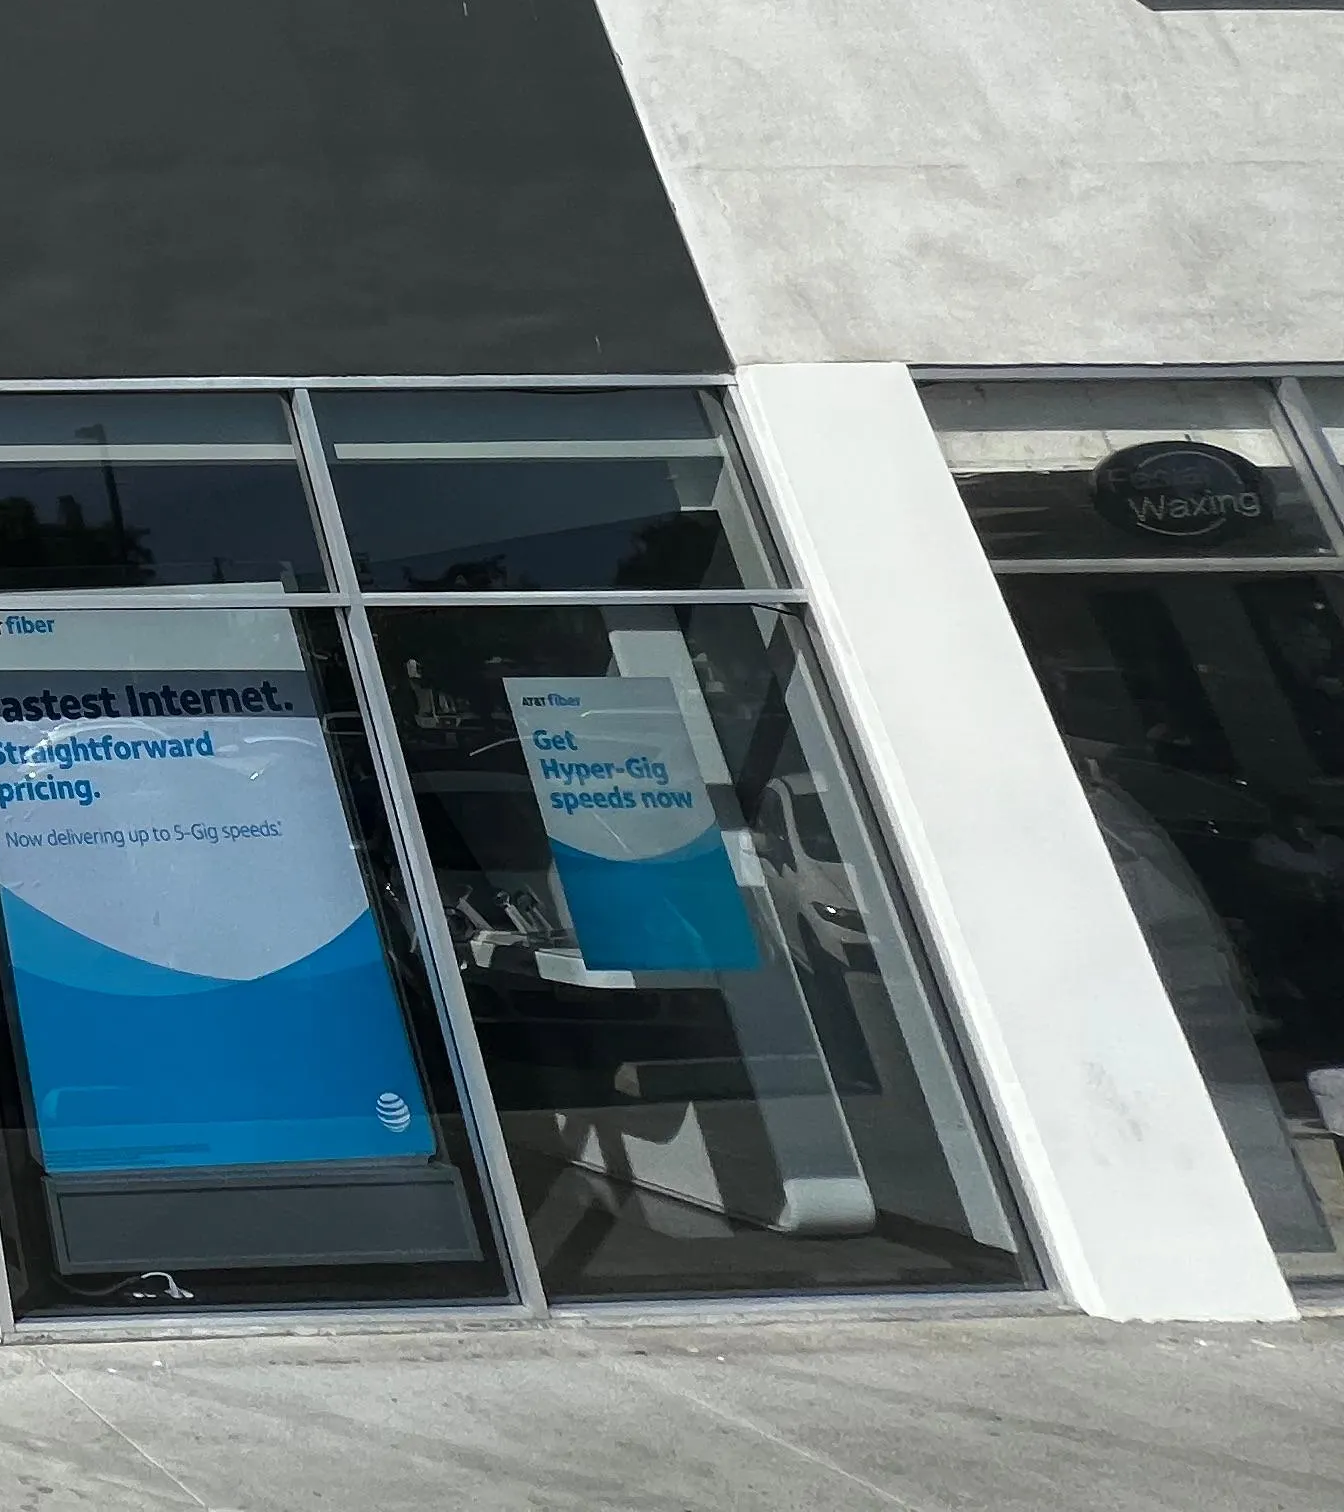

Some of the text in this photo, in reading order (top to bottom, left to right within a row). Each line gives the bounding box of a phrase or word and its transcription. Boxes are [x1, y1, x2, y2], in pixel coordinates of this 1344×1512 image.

[1128, 490, 1261, 522] Waxing
[5, 615, 55, 635] fiber
[127, 680, 294, 717] Internet.
[522, 697, 546, 707] AT&T
[532, 729, 578, 751] Get
[540, 756, 669, 786] Hyper-Gig
[551, 786, 694, 815] speeds now
[6, 831, 42, 847] Now
[47, 828, 125, 847] delivering
[128, 830, 149, 847] up
[152, 827, 171, 842] to
[174, 822, 219, 844] 5-Gig
